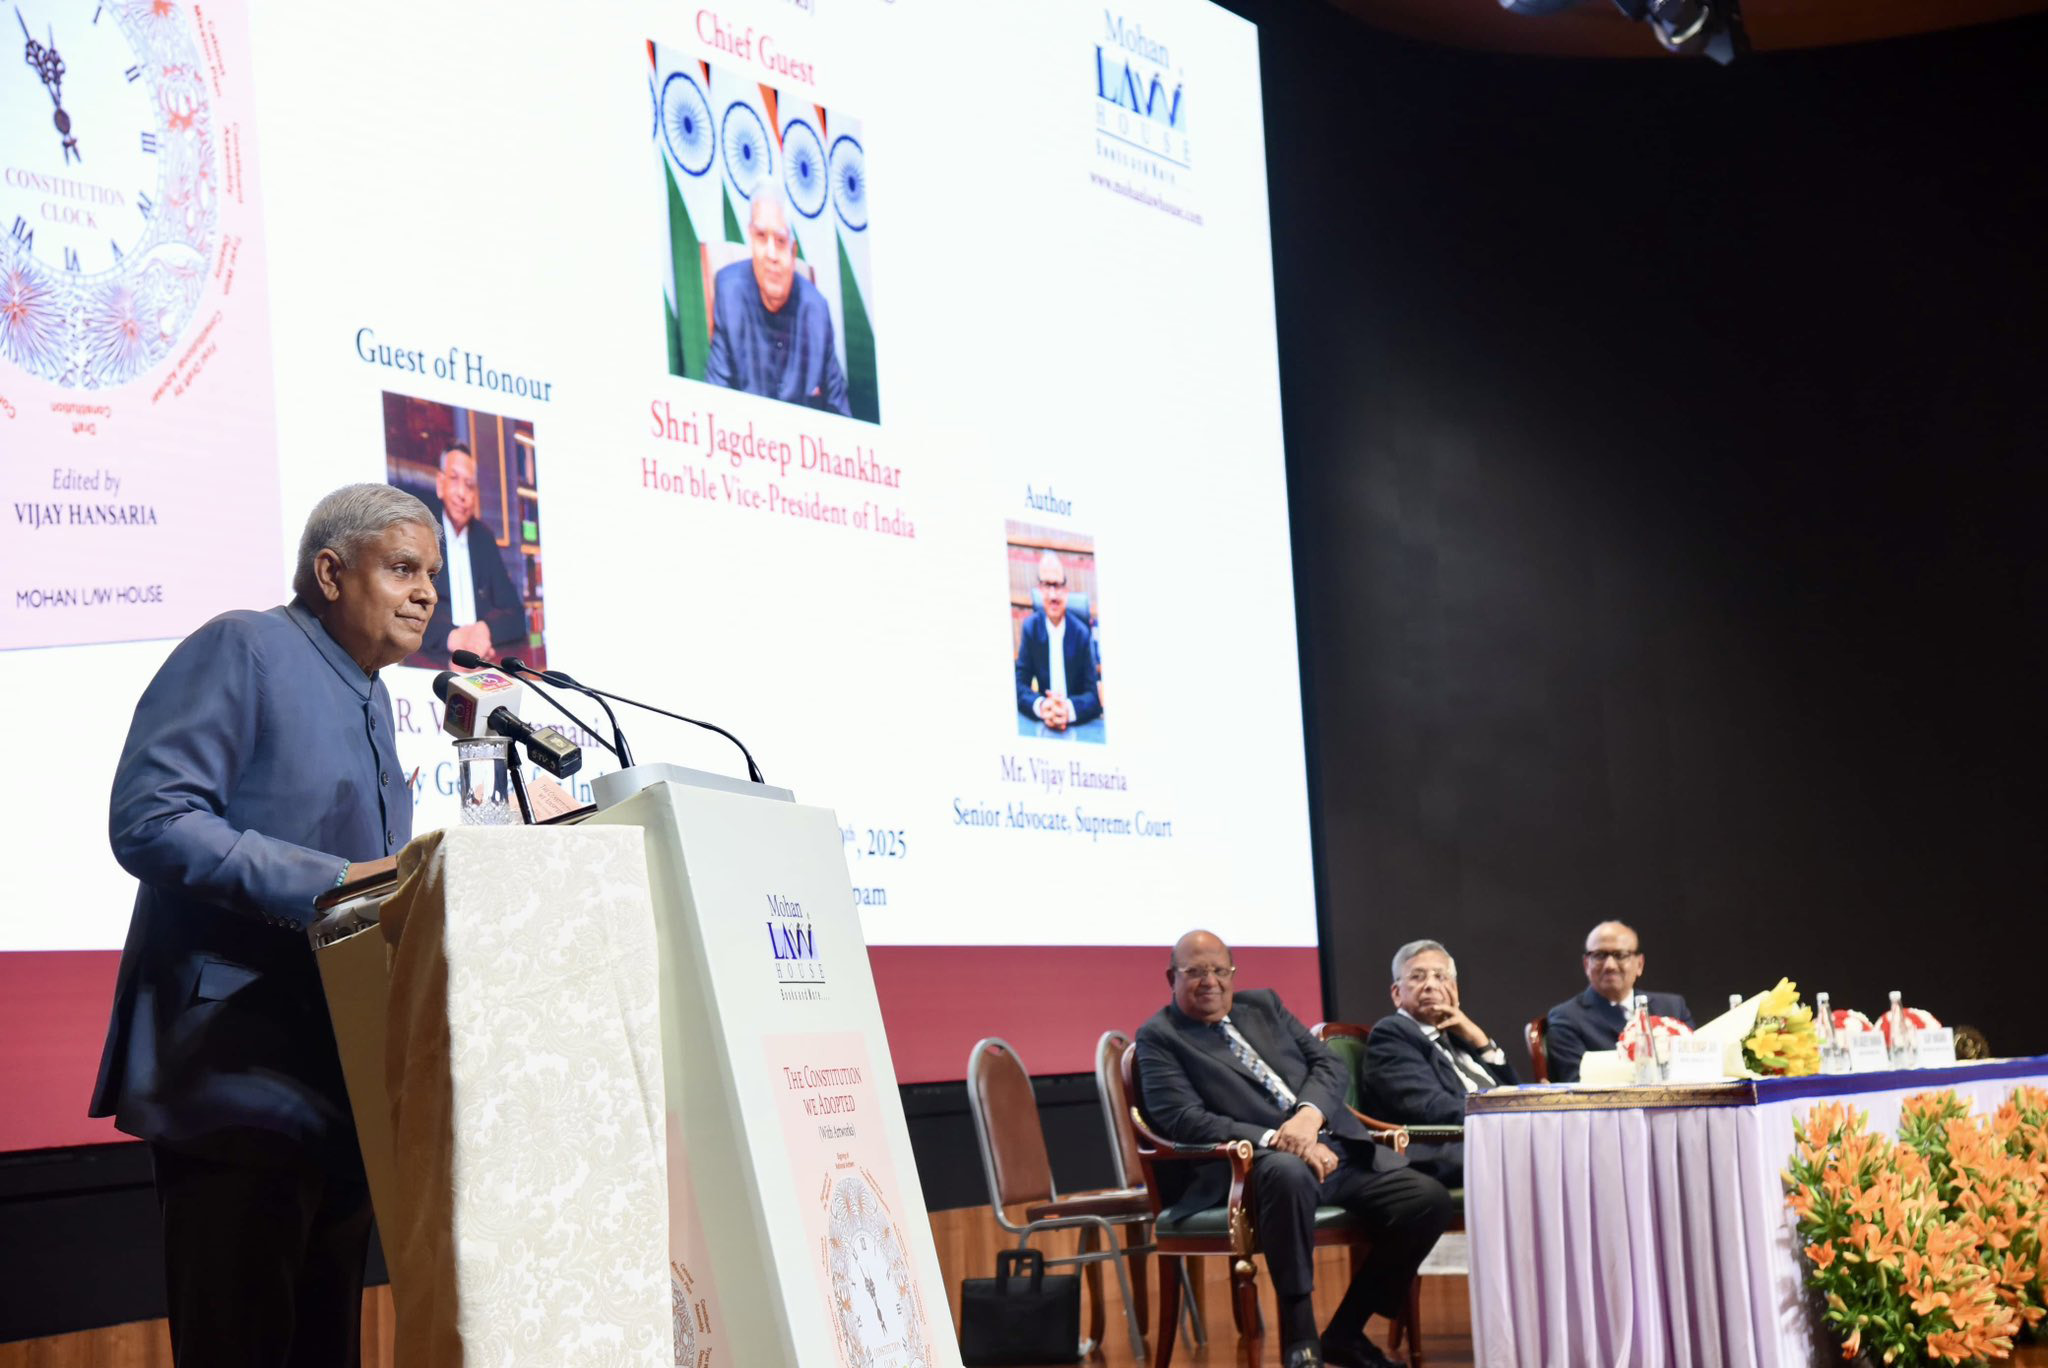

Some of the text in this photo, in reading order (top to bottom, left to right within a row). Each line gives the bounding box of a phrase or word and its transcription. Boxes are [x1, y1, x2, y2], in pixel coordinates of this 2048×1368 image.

[696, 9, 815, 86] Chief Guest
[1105, 8, 1169, 69] Mohan
[1094, 43, 1183, 128] LAW
[1096, 102, 1191, 163] HOUSE
[5, 167, 126, 207] CONSTITUTION
[41, 201, 97, 230] CLOCK
[356, 328, 552, 402] Guest of Honour
[650, 399, 902, 489] Shri Jagdeep Dhankhar
[53, 468, 121, 497] Edited by
[641, 457, 916, 539] Hon'ble Vice-President of India
[1023, 484, 1072, 517] Author
[14, 503, 158, 530] VIJAY HANSARIA
[17, 585, 163, 608] MOHAN LAW HOUSE
[396, 698, 421, 733] R.
[1001, 754, 1128, 795] Mr. Vijay Hansaria
[953, 798, 1173, 842] Senior Advocate, Supreme Court
[868, 829, 907, 859] 2025
[767, 894, 803, 918] Mohan
[767, 922, 813, 960] LAW
[775, 963, 825, 979] HOUSE
[804, 1065, 863, 1089] CONSTITUTION
[817, 1092, 856, 1115] ADOPTED
